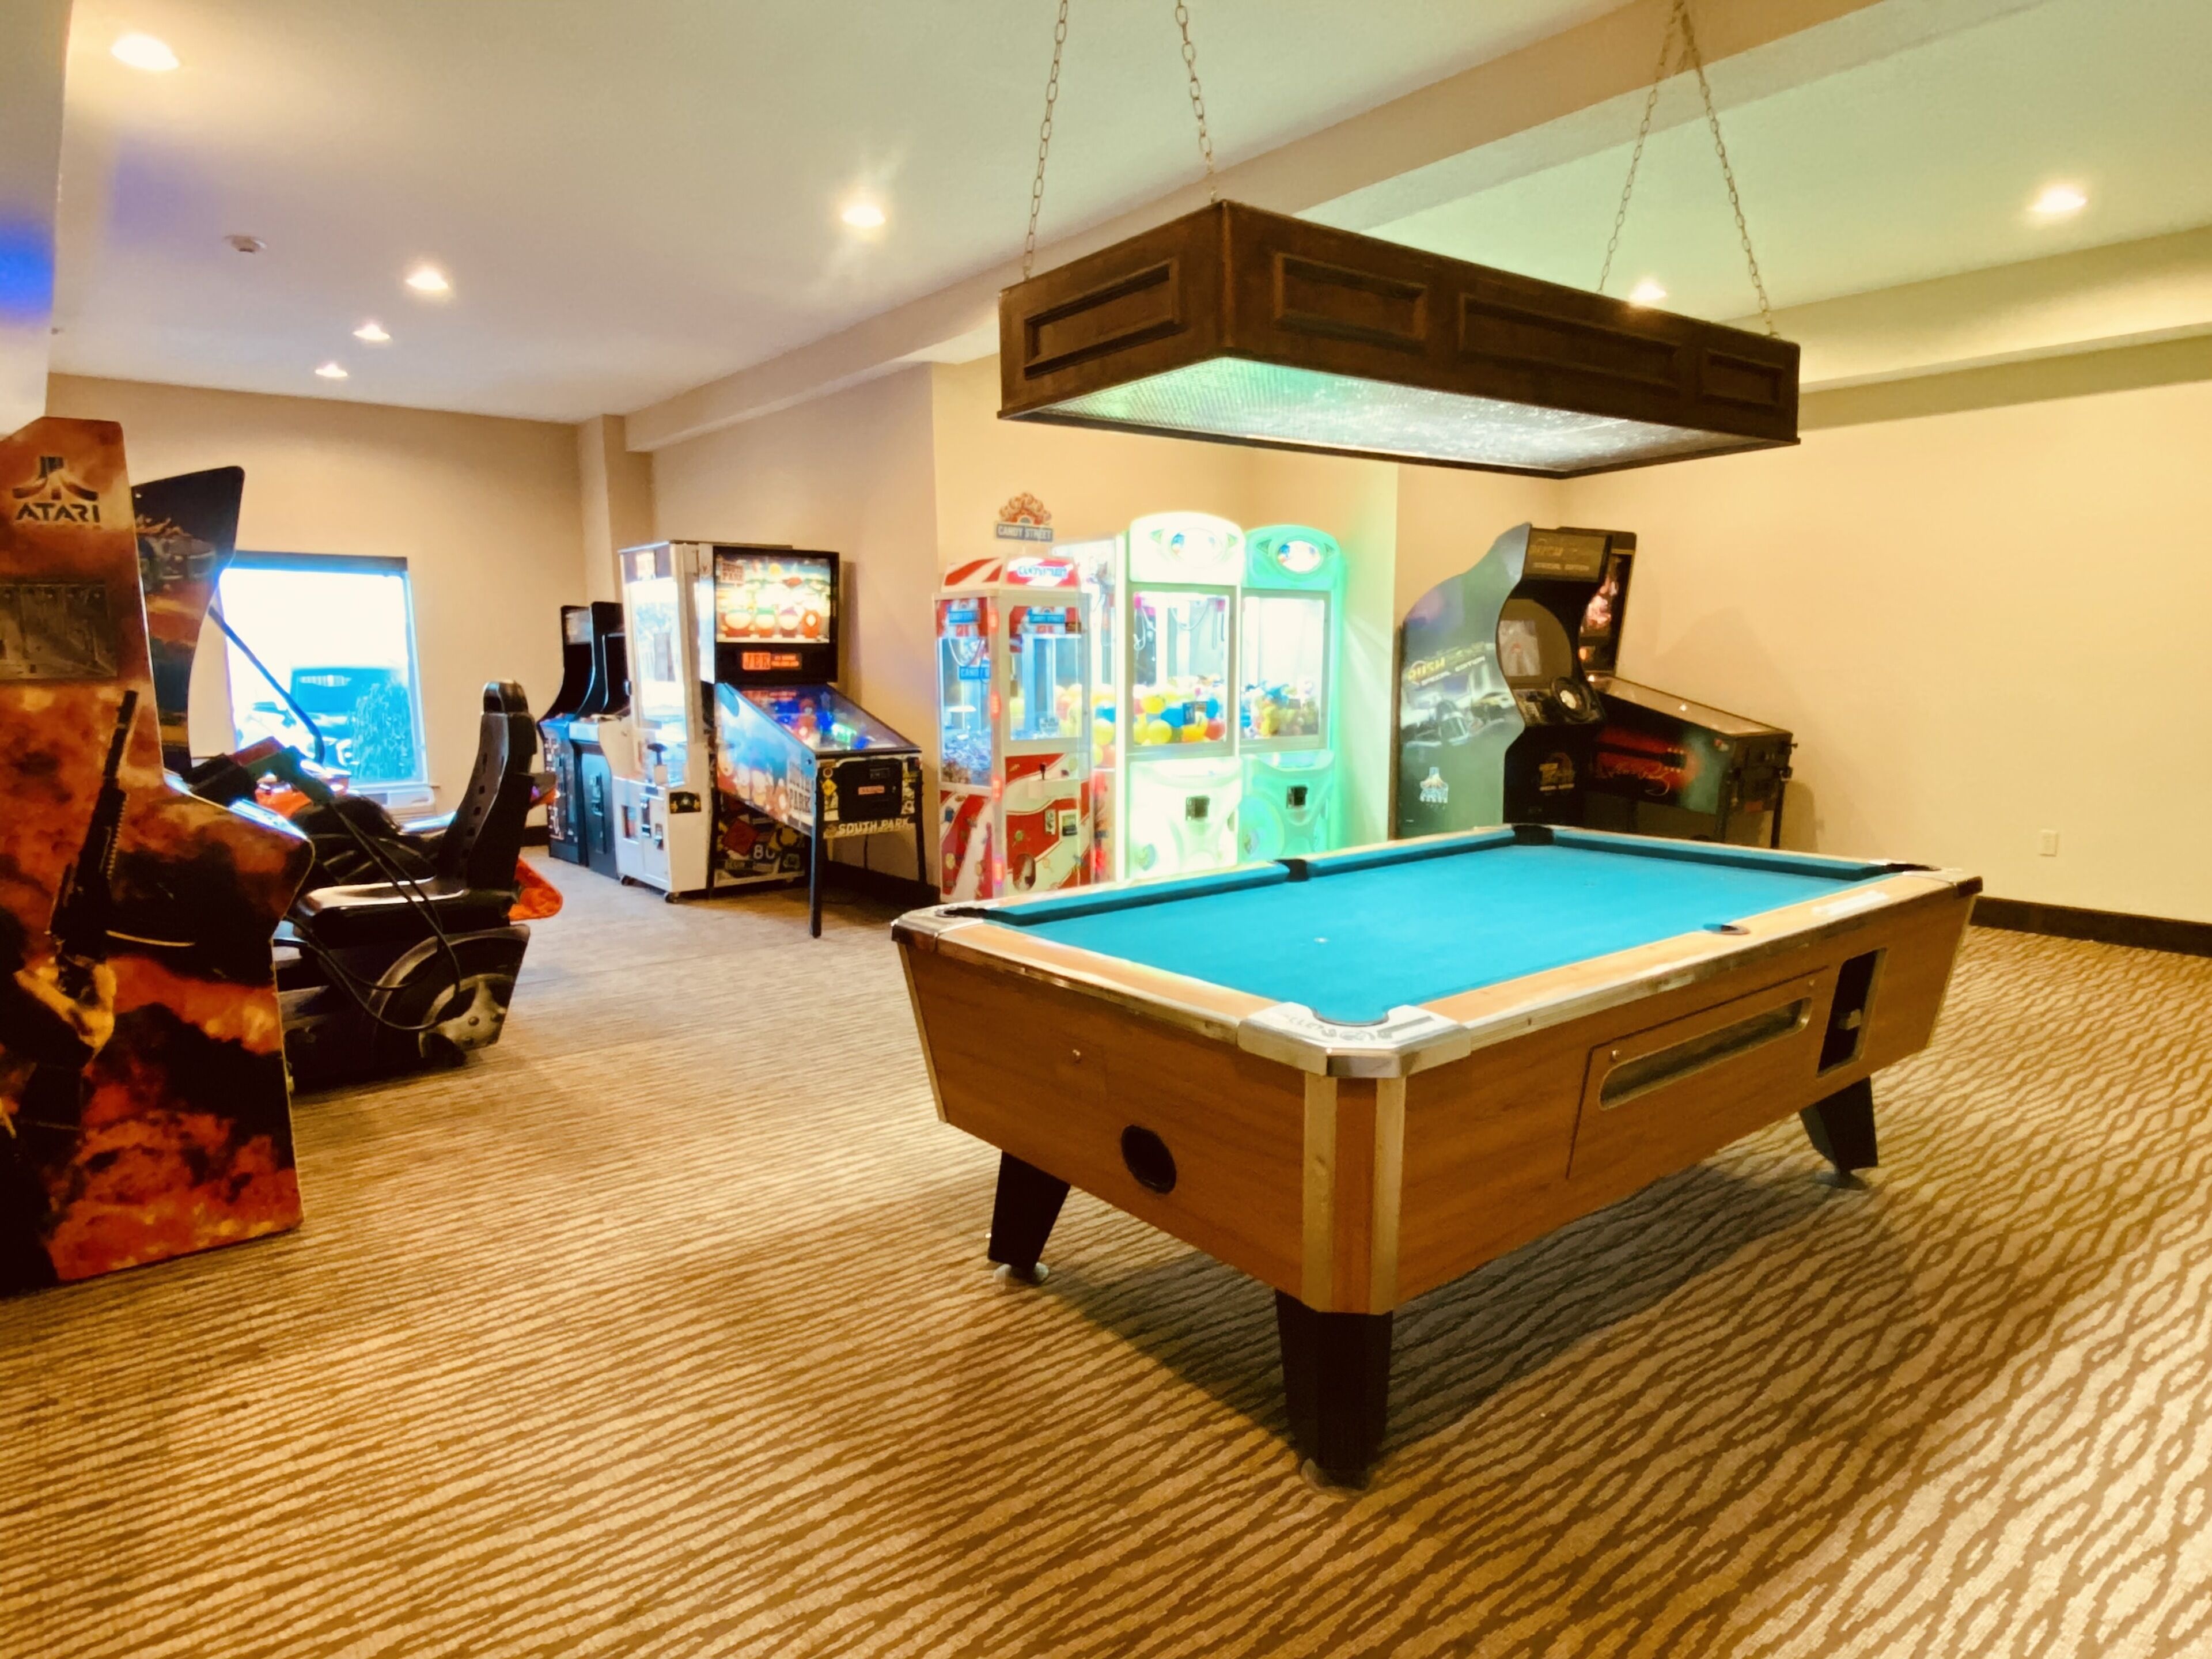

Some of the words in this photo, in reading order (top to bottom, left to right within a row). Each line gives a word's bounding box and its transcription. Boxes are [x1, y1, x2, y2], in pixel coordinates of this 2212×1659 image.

[16, 502, 100, 522] ATARI
[998, 525, 1024, 537] CANDY
[1025, 528, 1051, 540] STREET
[1408, 656, 1445, 681] RUSH
[789, 787, 811, 813] PARK
[838, 819, 878, 836] SOUTH
[880, 817, 909, 832] PARK
